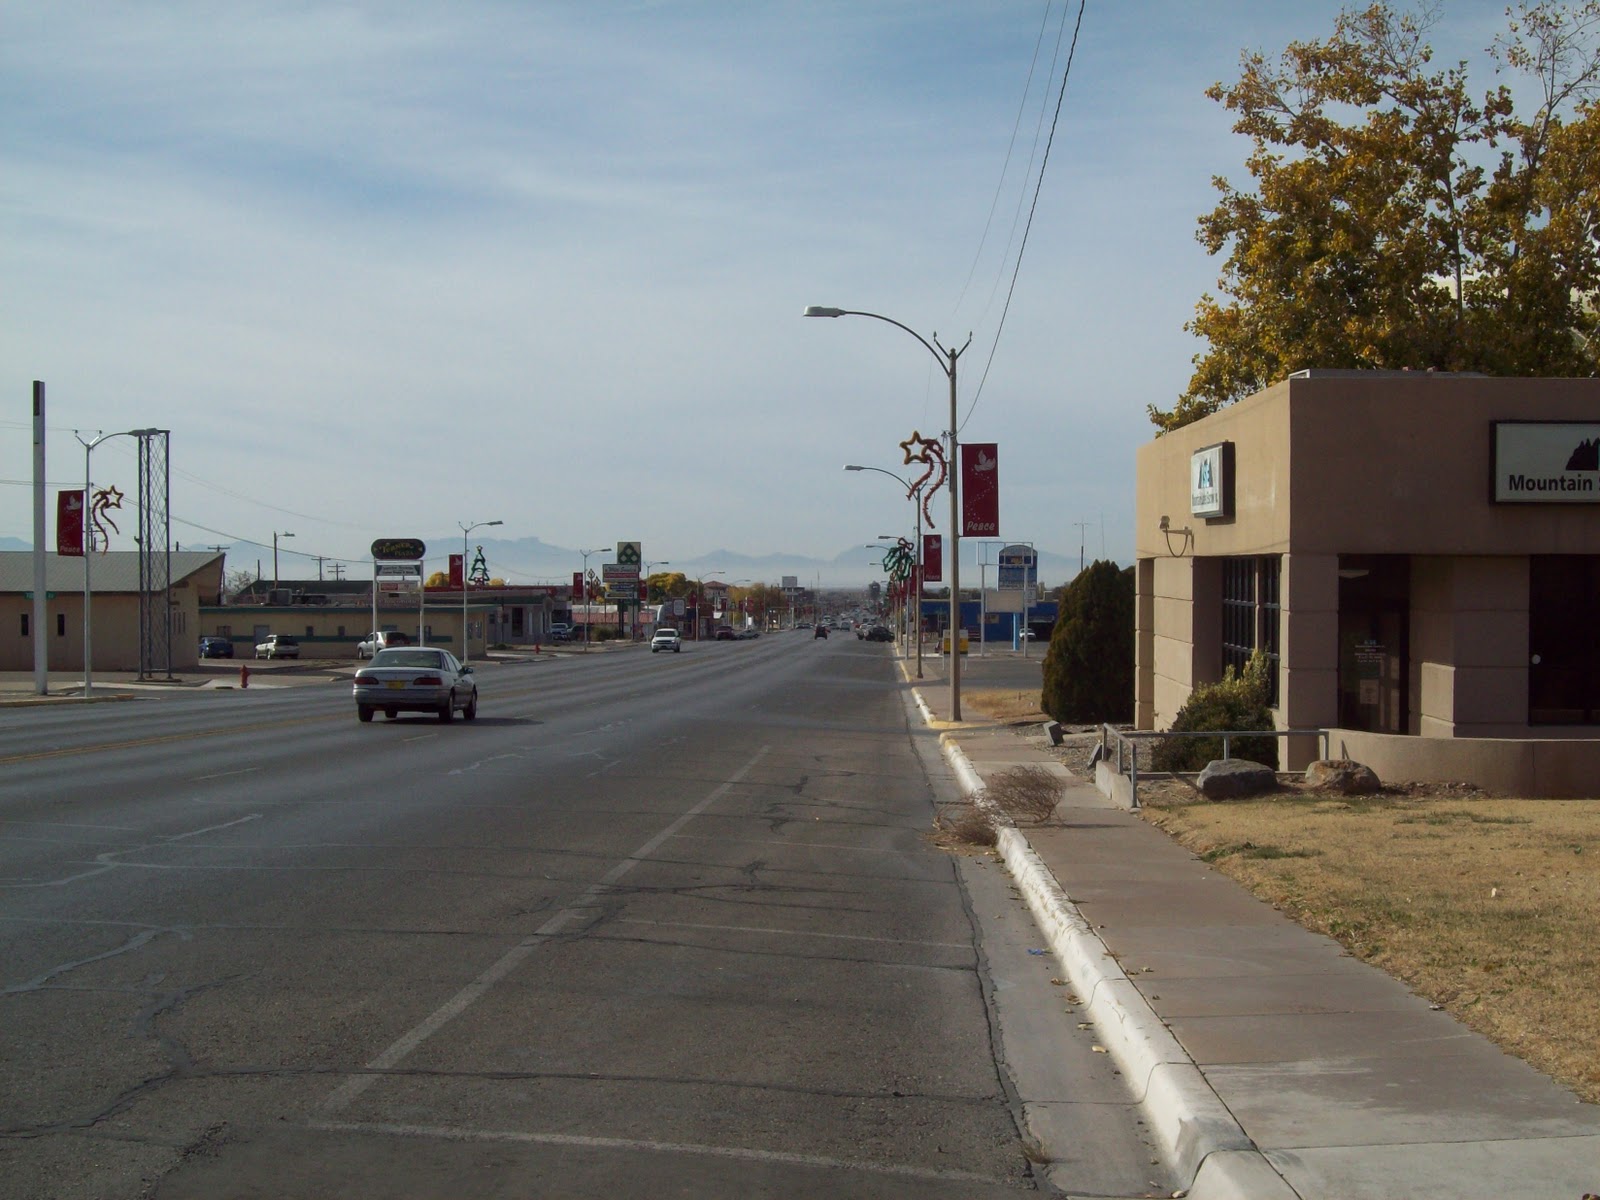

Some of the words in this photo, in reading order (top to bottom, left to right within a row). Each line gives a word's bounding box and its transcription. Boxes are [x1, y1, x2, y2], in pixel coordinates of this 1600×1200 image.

[1509, 474, 1592, 491] Mountain
[966, 521, 995, 532] Peace
[59, 545, 81, 553] Peace
